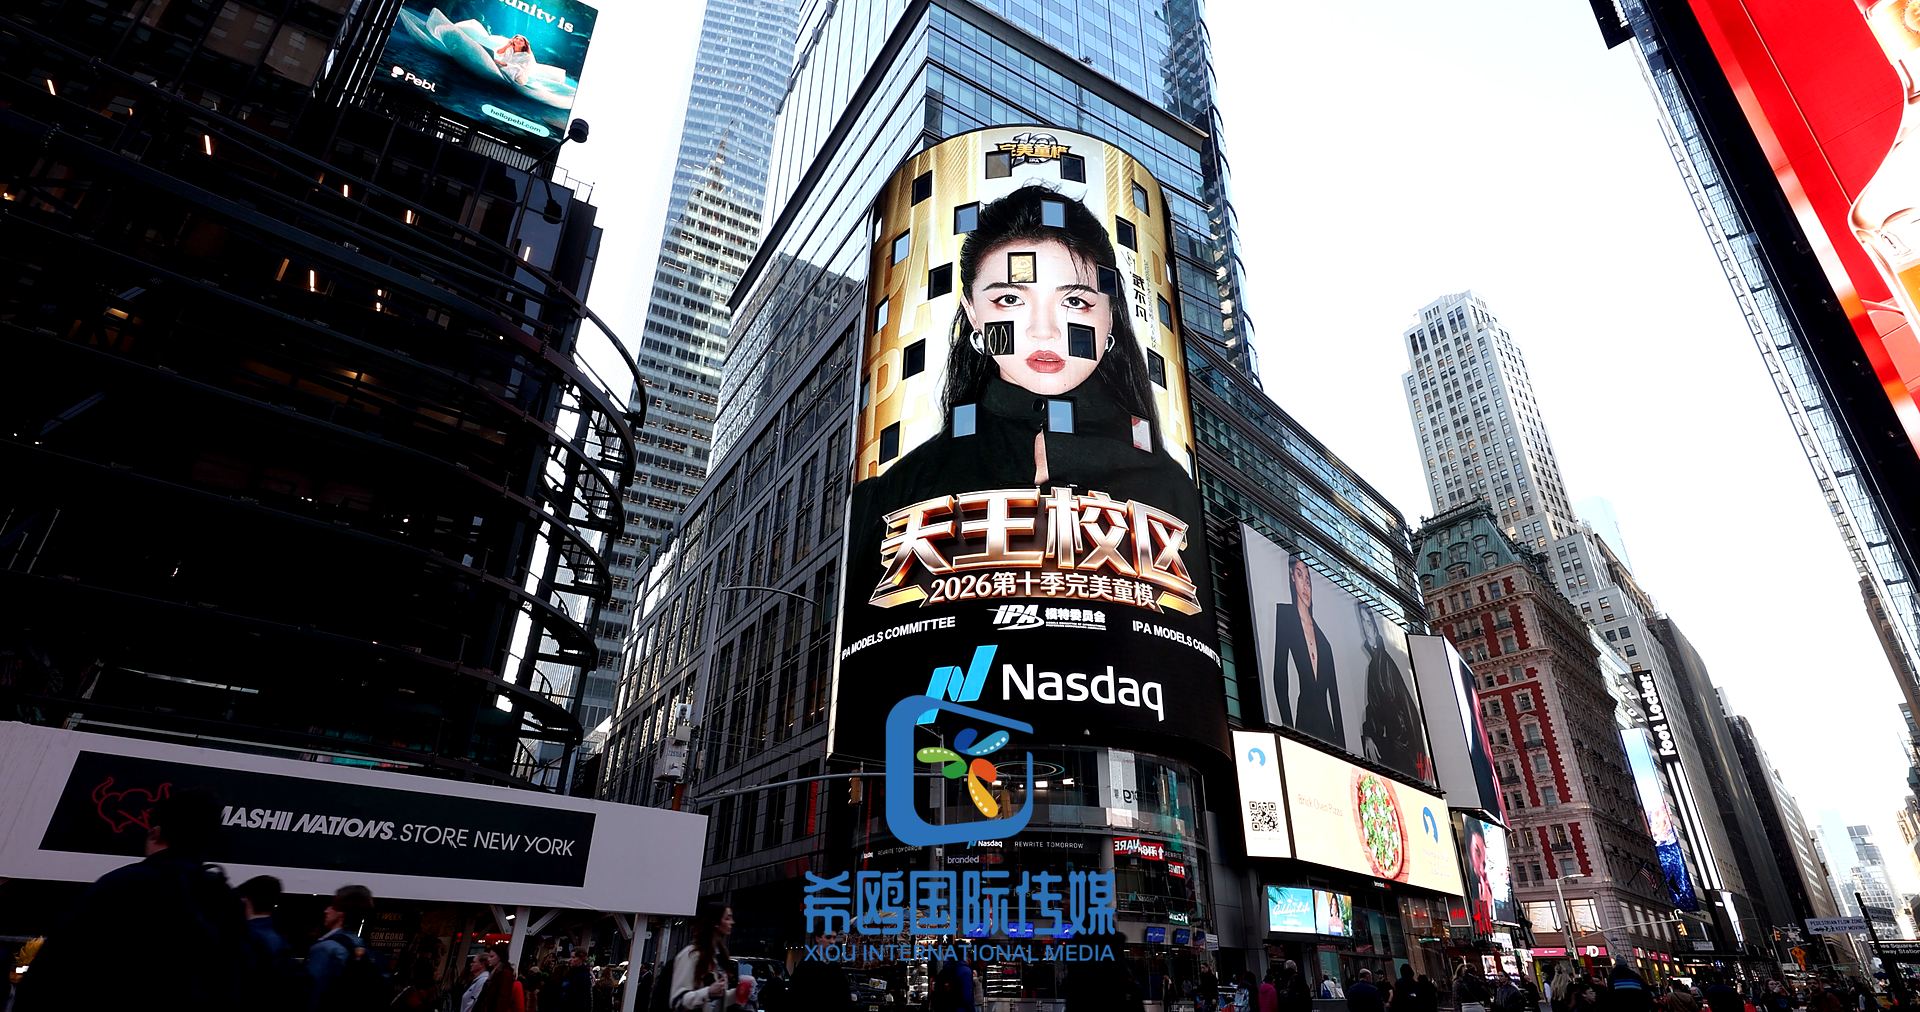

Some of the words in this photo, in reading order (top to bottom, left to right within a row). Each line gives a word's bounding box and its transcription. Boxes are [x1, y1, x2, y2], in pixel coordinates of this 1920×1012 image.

[499, 0, 556, 23] unity
[557, 17, 574, 33] is
[404, 72, 436, 92] Pebl
[490, 108, 541, 133] hellopebl.com
[1132, 273, 1149, 323] 武不凡
[874, 485, 1198, 598] 天王校区
[928, 571, 1156, 610] 2026第十季完美童模
[990, 604, 1042, 627] IPA
[1045, 607, 1106, 624] 模特委员会
[851, 632, 884, 655] MODELS
[884, 616, 956, 640] COMMITTEE
[1132, 620, 1152, 635] IPA
[1153, 625, 1193, 647] MODELS
[1001, 663, 1165, 723] Nasdaq
[1639, 673, 1665, 722] Locker
[1652, 723, 1677, 756] Foot
[292, 813, 395, 841] NATIONS
[400, 823, 469, 849] STORE
[473, 830, 521, 851] NEW
[523, 835, 576, 857] YORK
[977, 840, 1003, 848] Nasdaq
[1047, 841, 1084, 849] TOMORROW
[947, 855, 980, 864] branded
